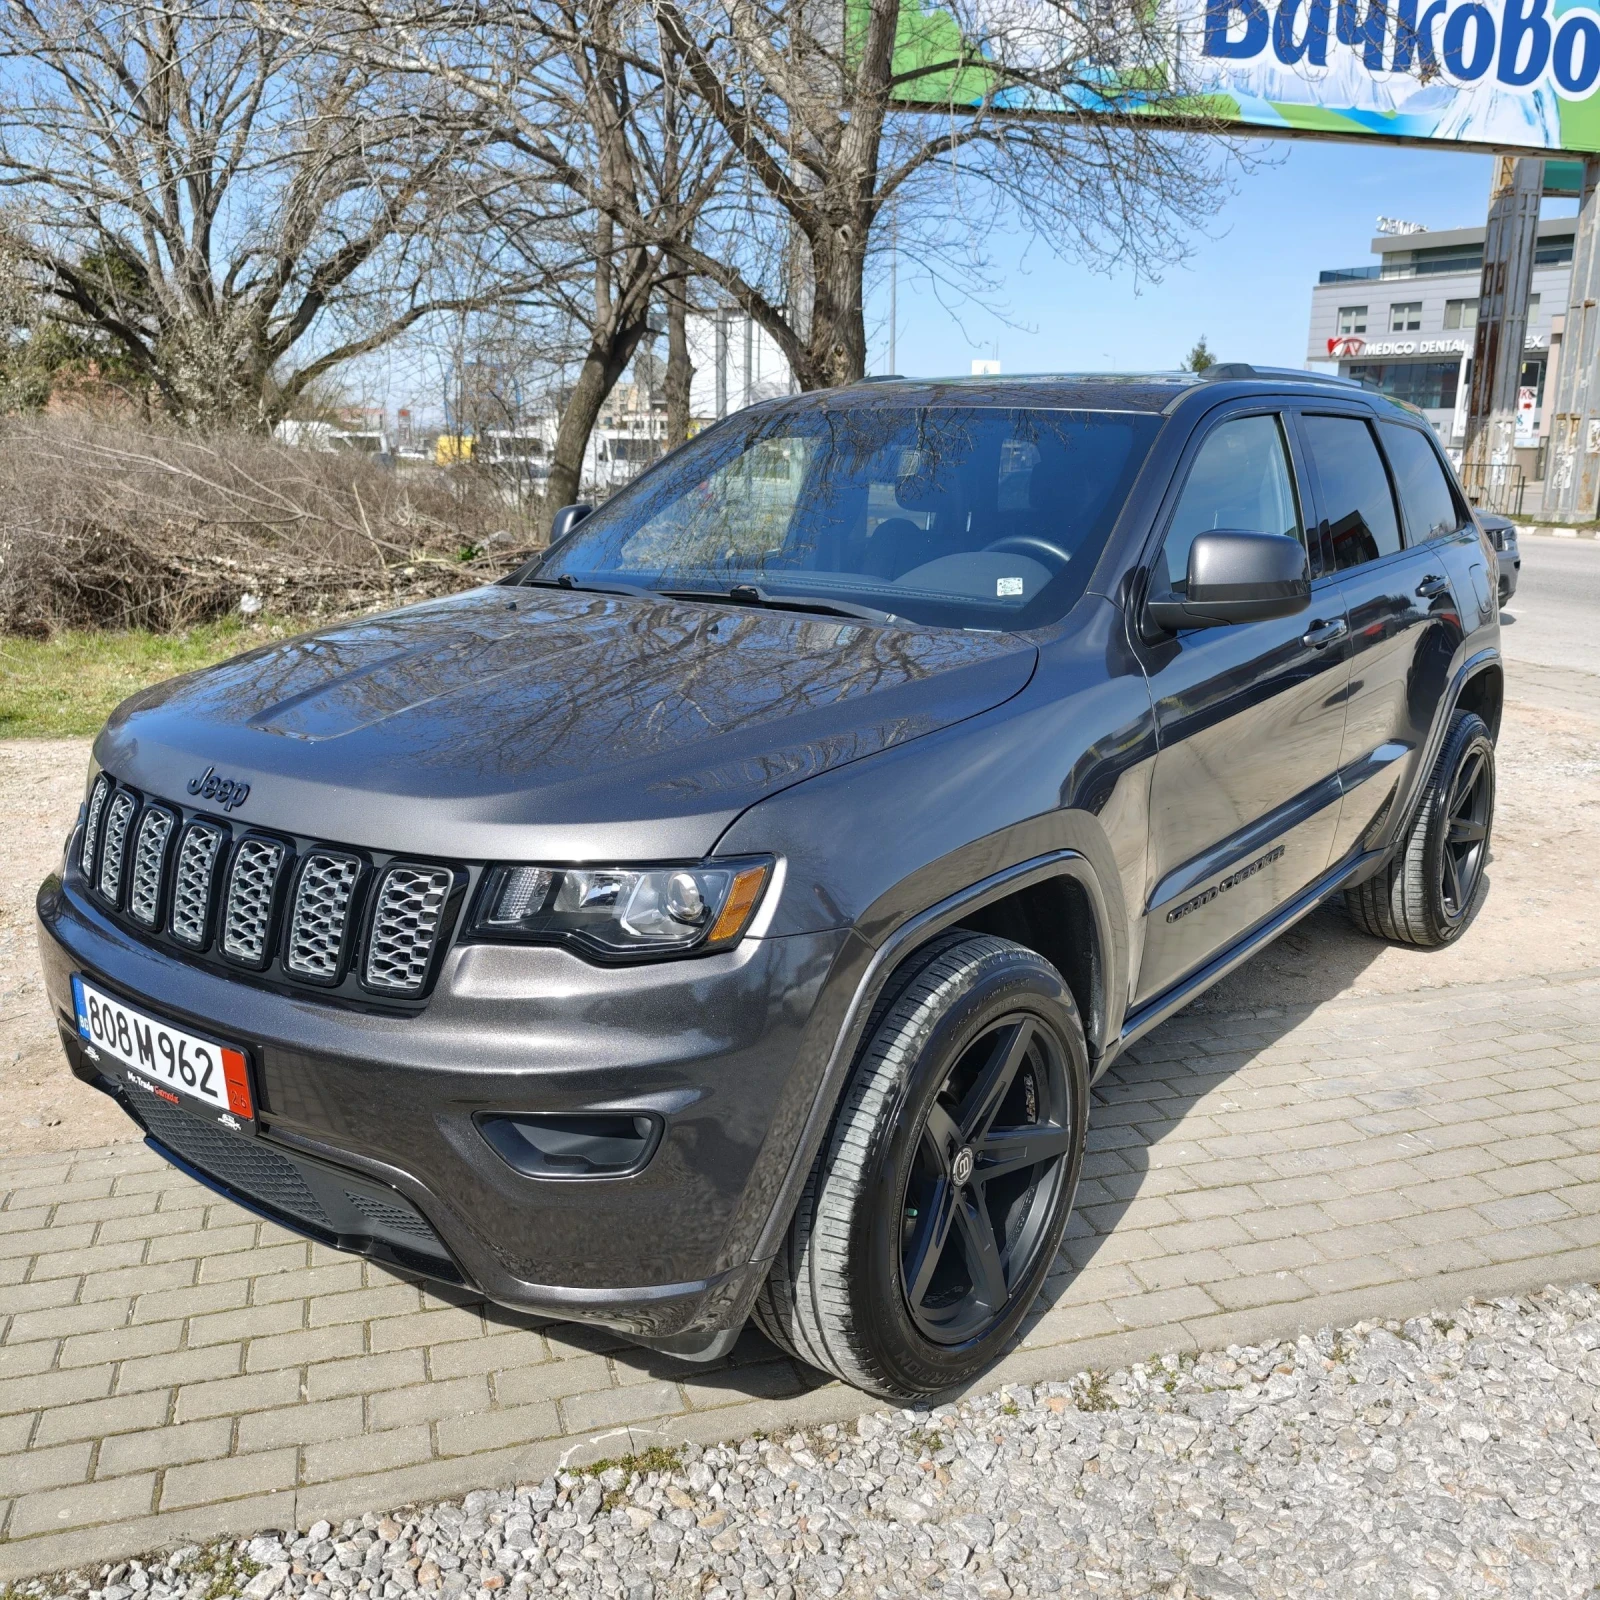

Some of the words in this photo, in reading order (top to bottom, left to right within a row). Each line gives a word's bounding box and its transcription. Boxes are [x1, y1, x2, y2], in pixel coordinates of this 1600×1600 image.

[1363, 341, 1415, 356] MEDICO
[1420, 339, 1466, 353] DENTAL
[187, 766, 250, 812] Jeep
[1166, 886, 1218, 923] GRAND
[79, 1015, 90, 1031] BG
